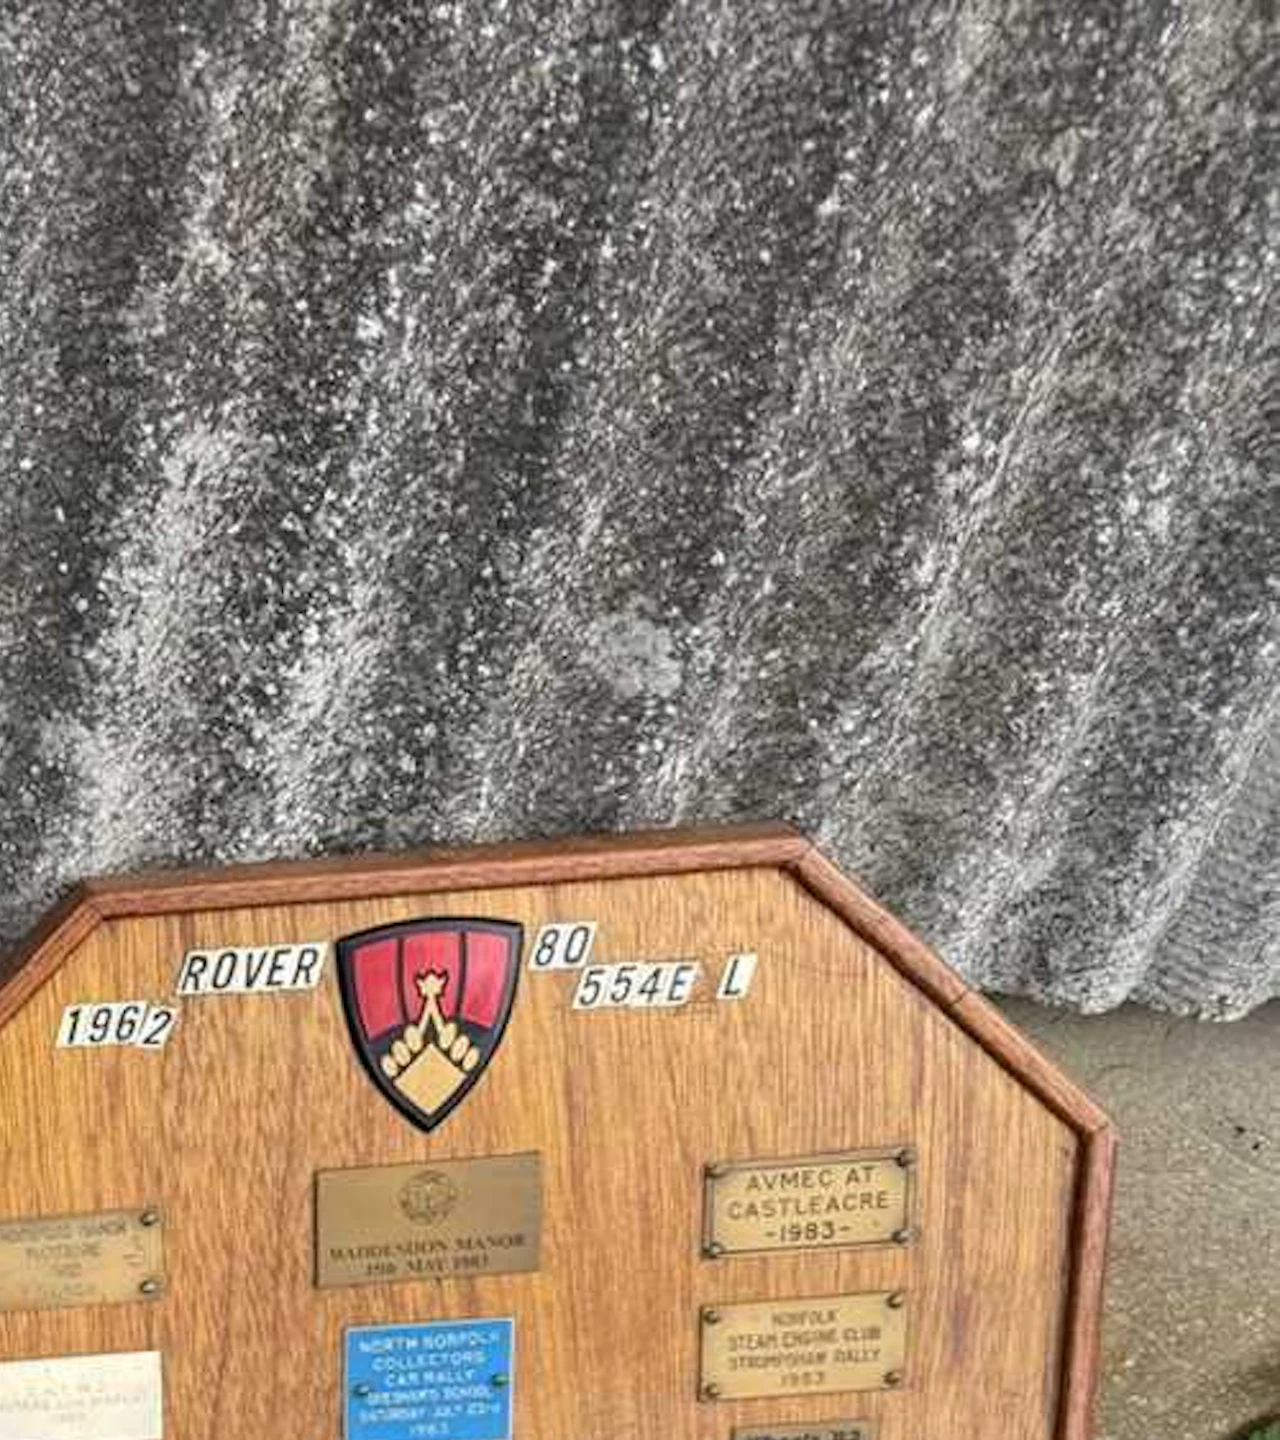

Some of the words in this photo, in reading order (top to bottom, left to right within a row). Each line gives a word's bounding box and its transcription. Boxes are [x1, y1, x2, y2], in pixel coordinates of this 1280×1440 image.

[533, 926, 591, 966] 80
[181, 948, 319, 991] ROVER
[65, 1005, 172, 1044] 1962
[746, 1168, 836, 1192] AVMEC
[845, 1166, 874, 1183] AT
[727, 1191, 891, 1220] CASTLEACRE
[771, 1310, 838, 1325] NORFOLK
[359, 1337, 418, 1352] NORTH
[833, 1348, 881, 1364] RALLY
[371, 1351, 486, 1371] COLLECTORS
[385, 1372, 419, 1386] CAR
[423, 1369, 474, 1384] RALLY
